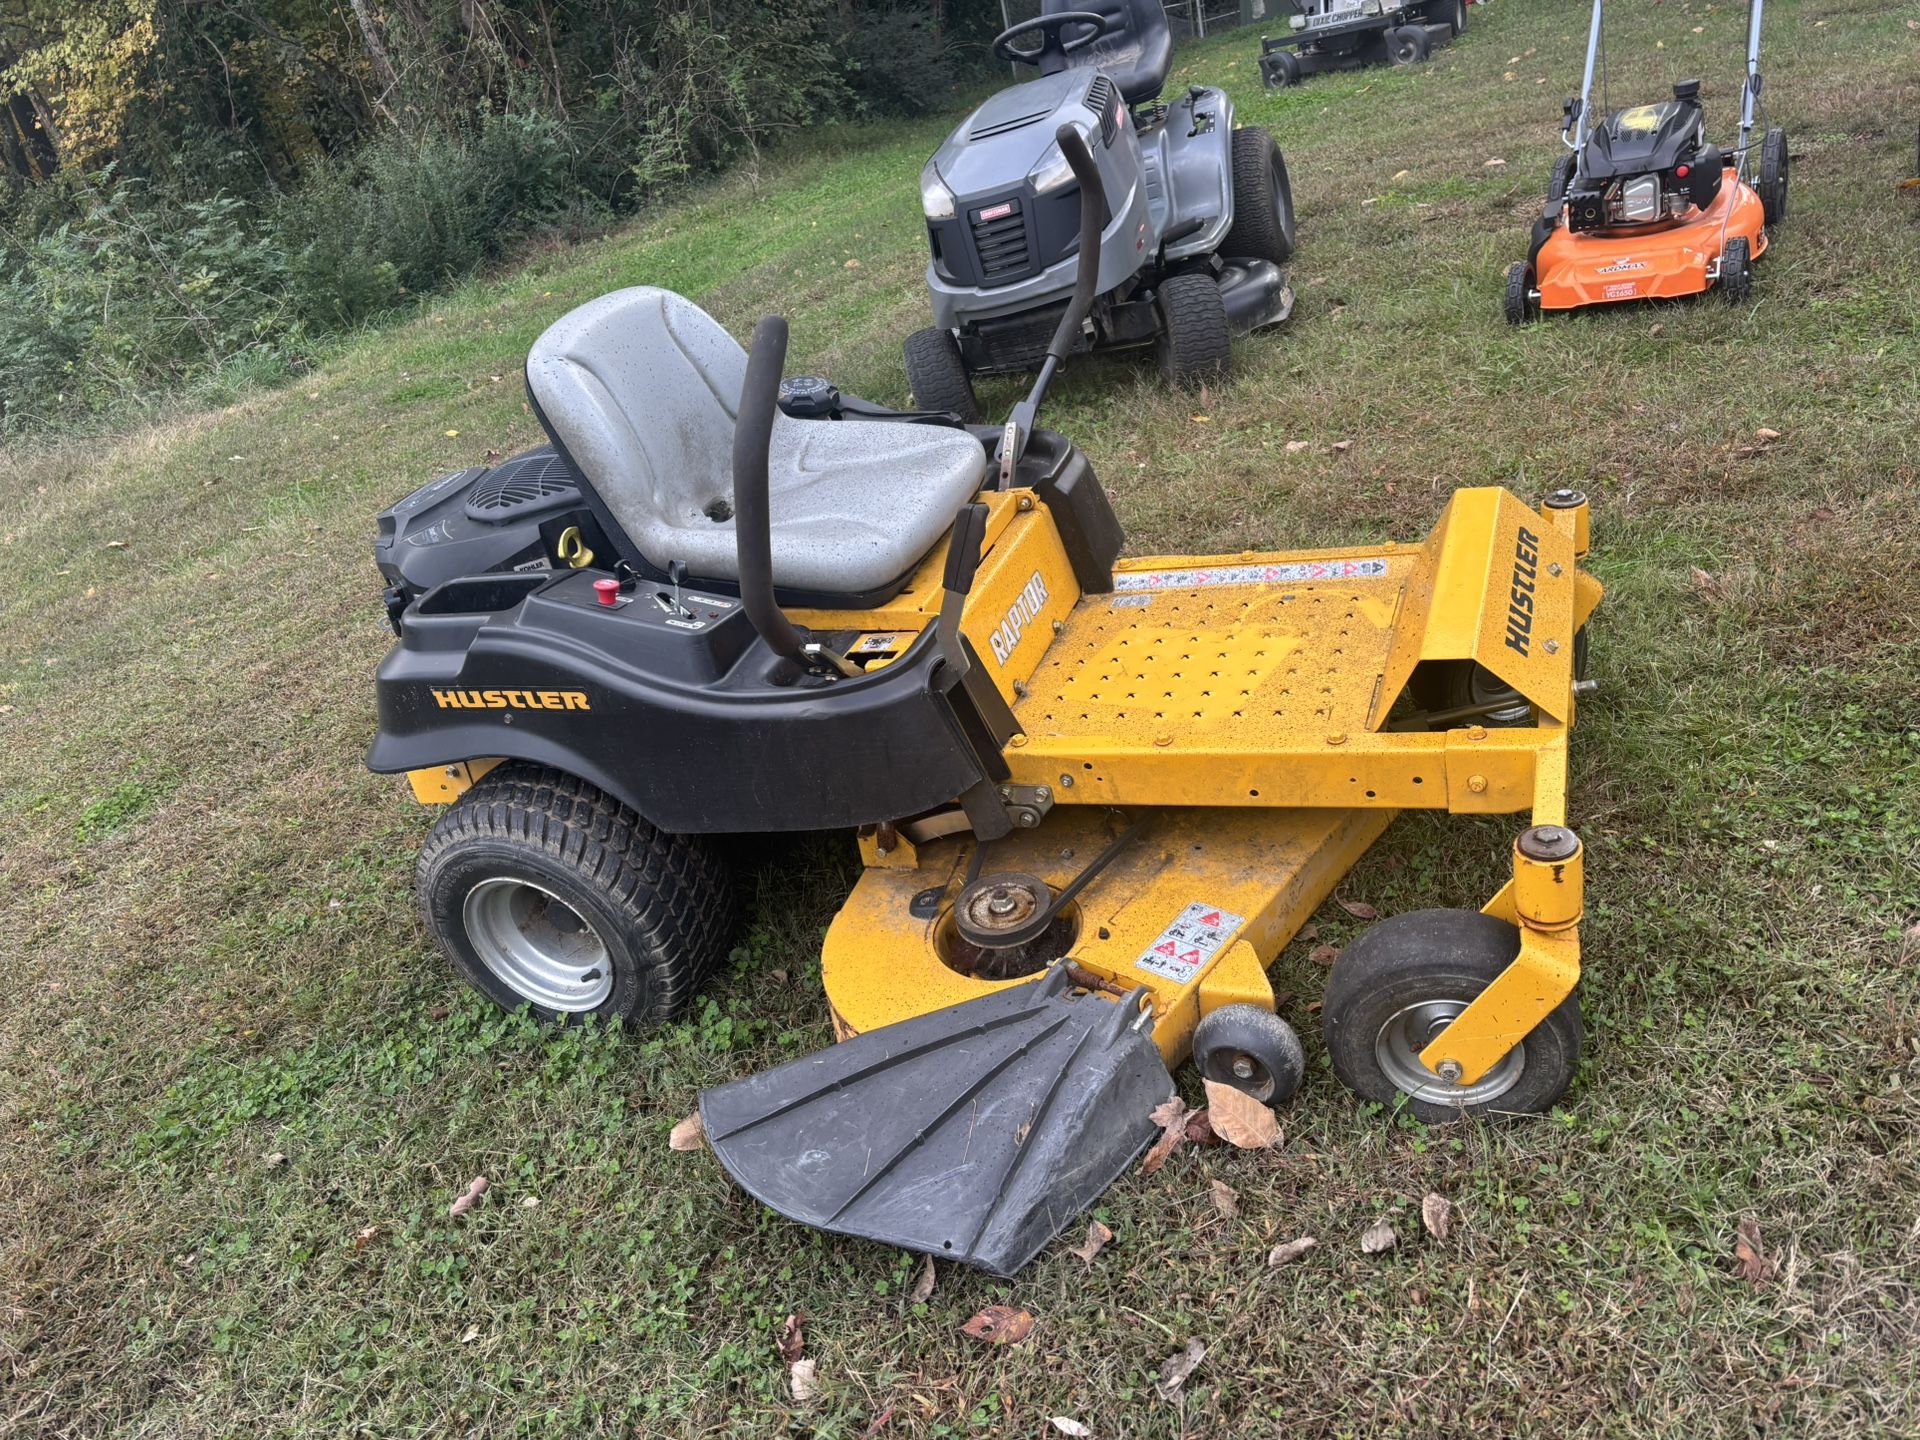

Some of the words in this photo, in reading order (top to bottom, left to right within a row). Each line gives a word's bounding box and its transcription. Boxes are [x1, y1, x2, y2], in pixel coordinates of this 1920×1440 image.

[1313, 15, 1331, 26] DIXIE
[1331, 8, 1363, 22] CHOPPER
[989, 569, 1049, 668] RAPTOR
[1505, 526, 1539, 658] HUSTLER
[431, 690, 591, 710] HUSTLER
